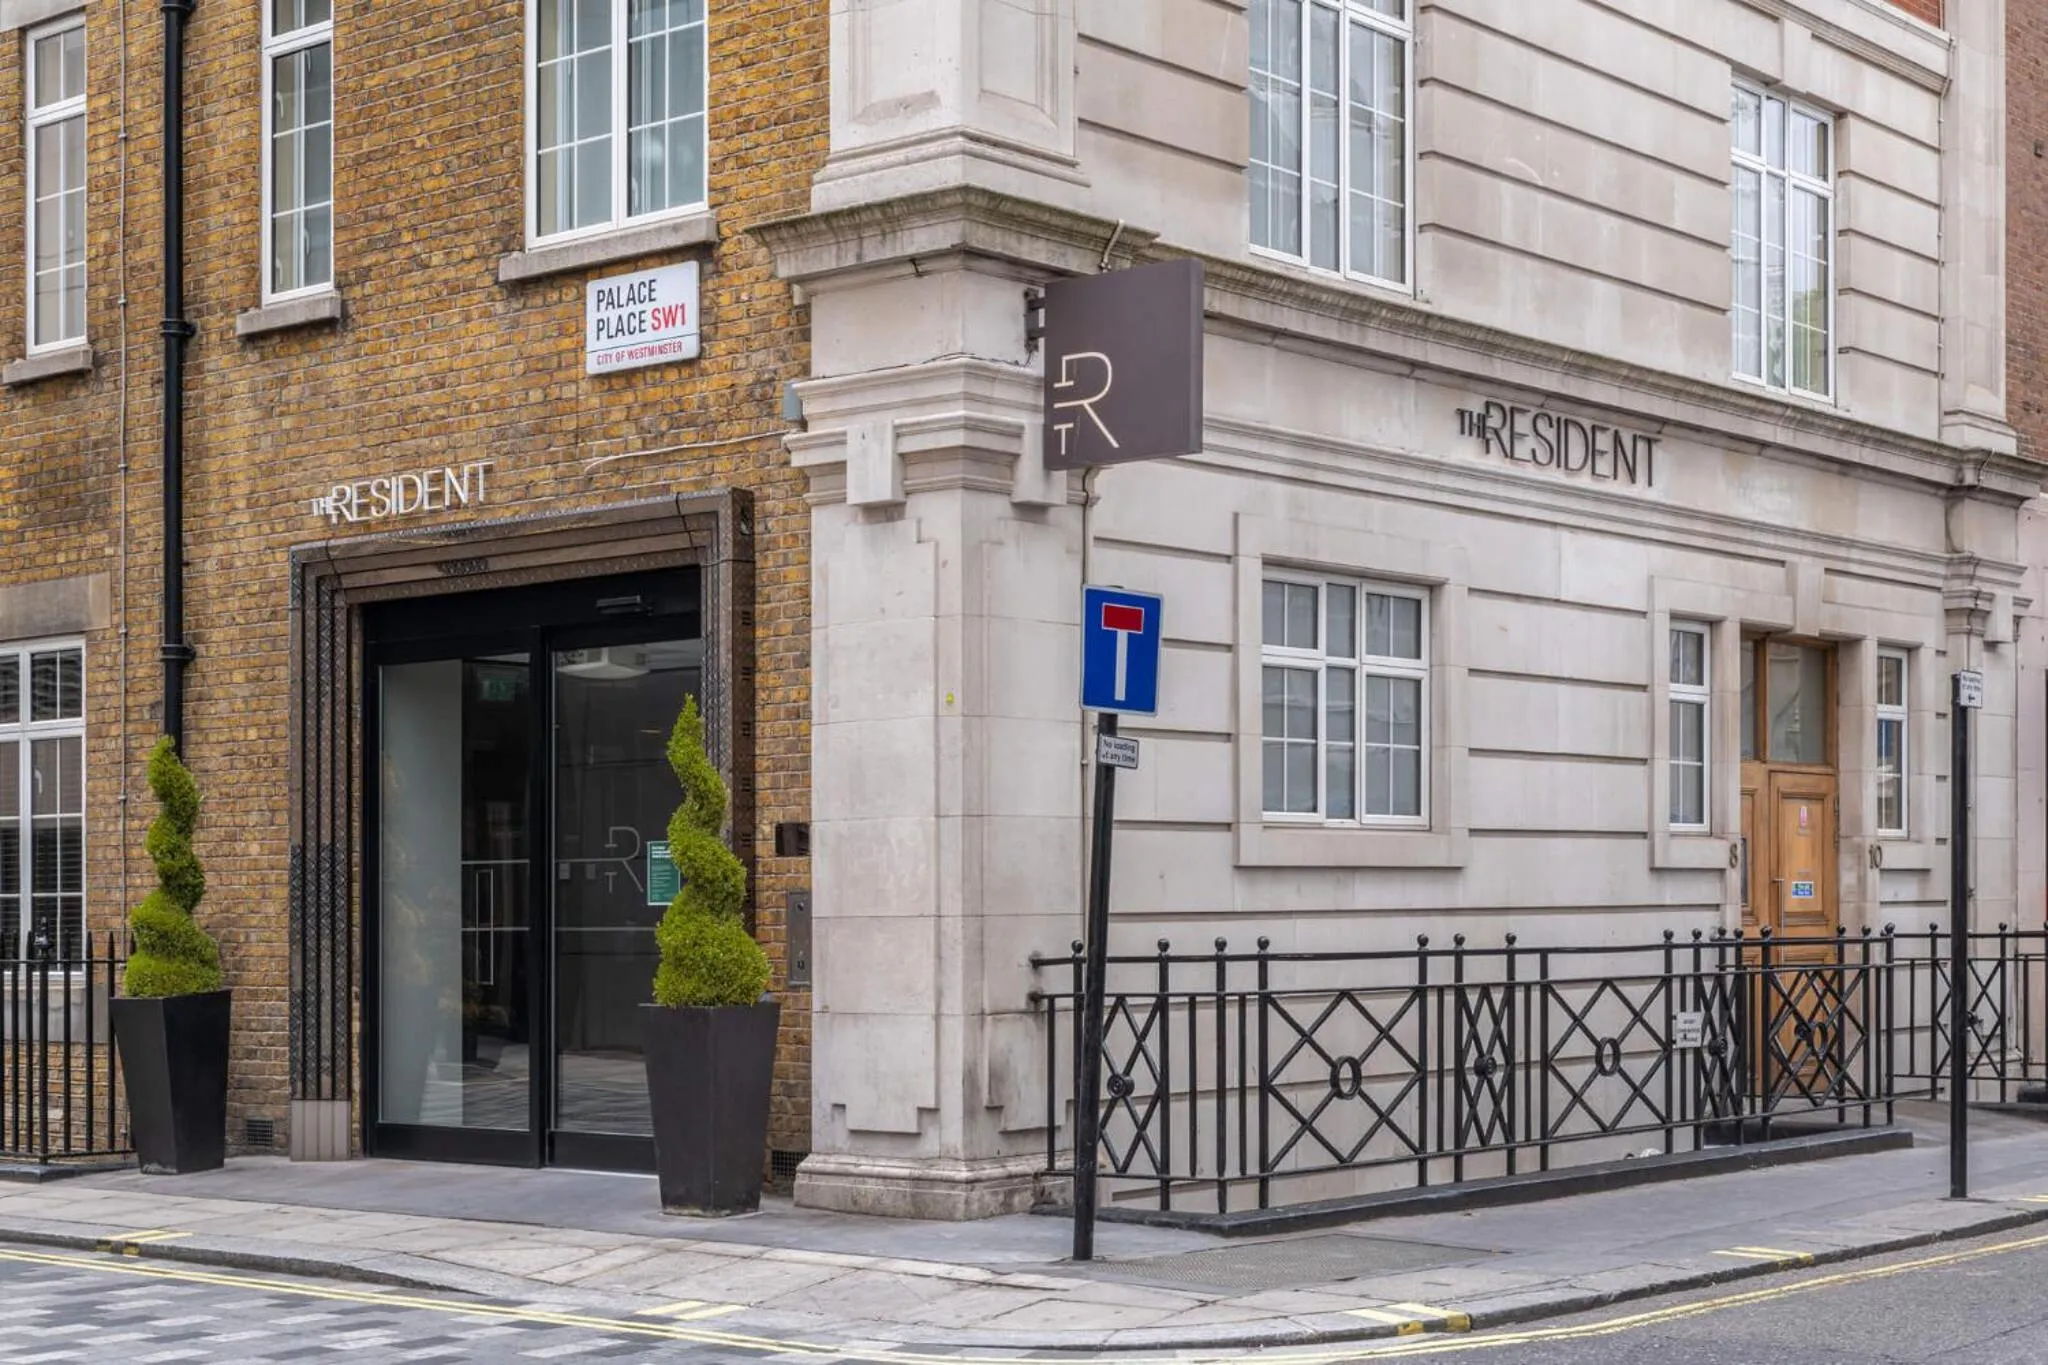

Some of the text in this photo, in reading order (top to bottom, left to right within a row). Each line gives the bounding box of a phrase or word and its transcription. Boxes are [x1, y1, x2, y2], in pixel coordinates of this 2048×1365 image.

[597, 279, 657, 312] PALACE
[596, 303, 686, 341] PLACE SW1
[597, 341, 682, 366] CITY OF WESTMINSTER
[1485, 400, 1662, 488] RESIDENT
[331, 461, 495, 525] RESIDENT
[1729, 842, 1738, 869] 8
[1868, 843, 1883, 870] 10
